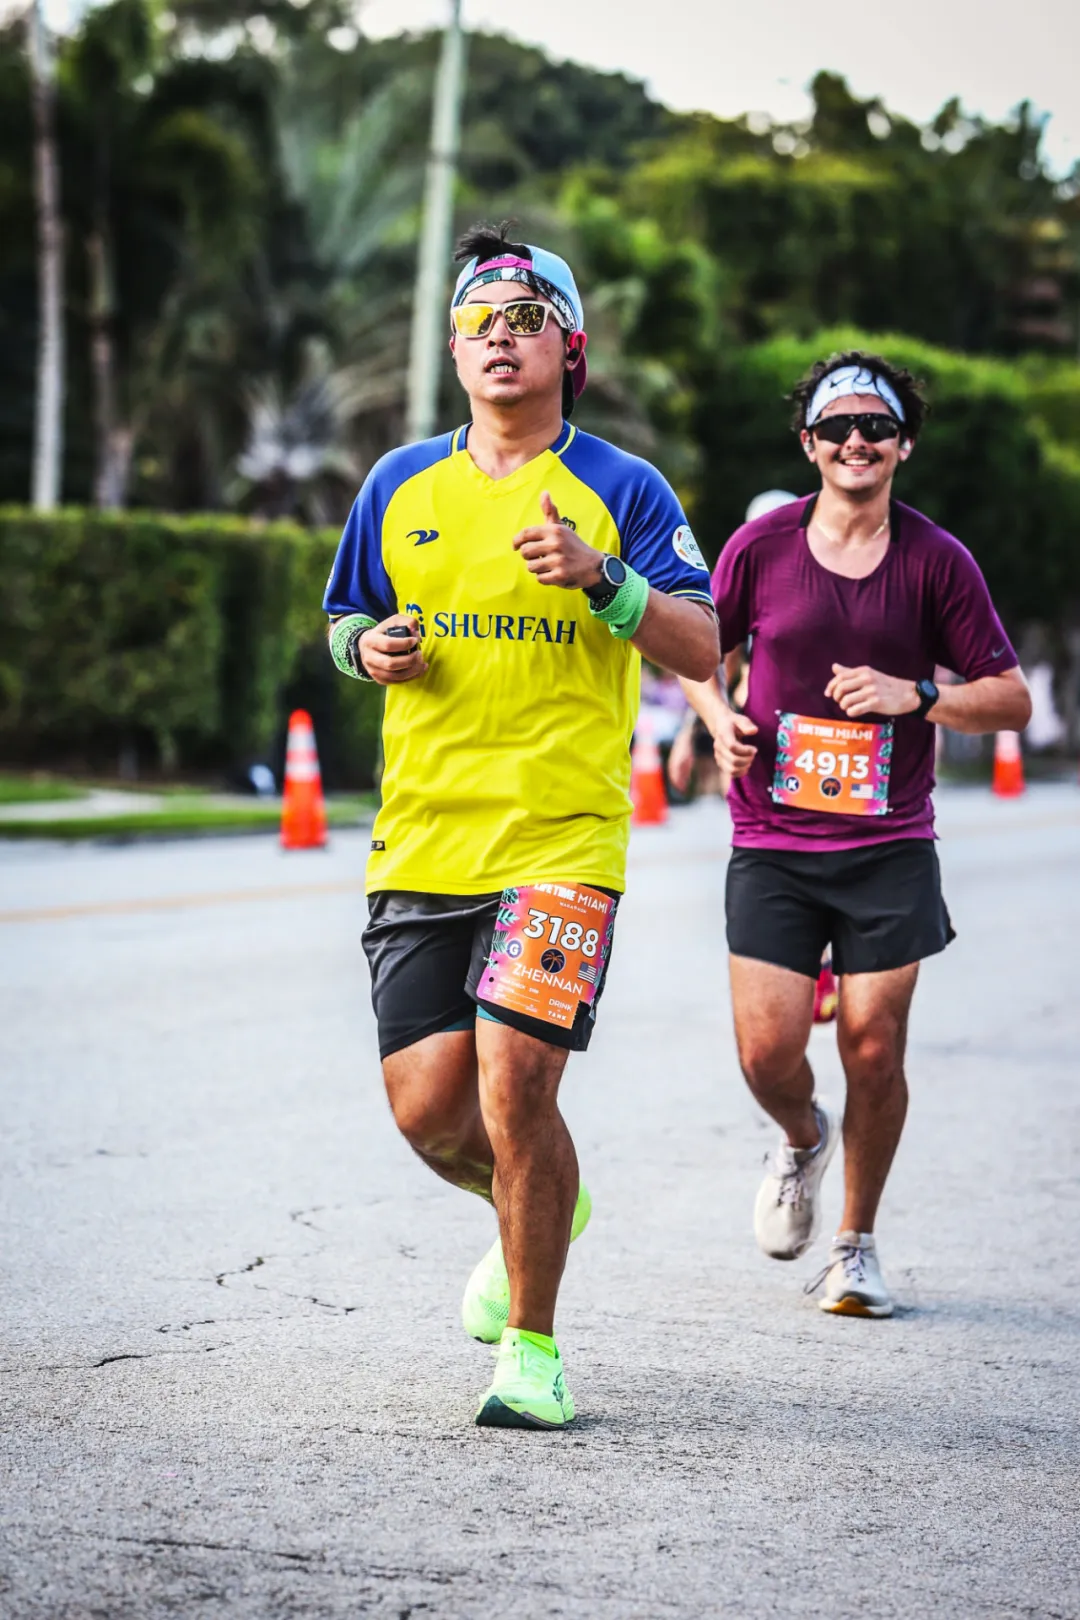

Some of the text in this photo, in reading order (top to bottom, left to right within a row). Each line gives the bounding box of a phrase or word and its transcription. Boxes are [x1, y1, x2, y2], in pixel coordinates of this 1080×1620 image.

[434, 612, 576, 644] SHURFAH
[836, 727, 873, 741] MIAMI
[794, 749, 869, 779] 4913
[788, 777, 798, 791] K
[577, 893, 608, 914] MIAMI
[522, 908, 599, 957] 3188
[510, 943, 520, 956] G
[512, 963, 583, 995] ZHENNAN
[548, 998, 573, 1011] DRINK
